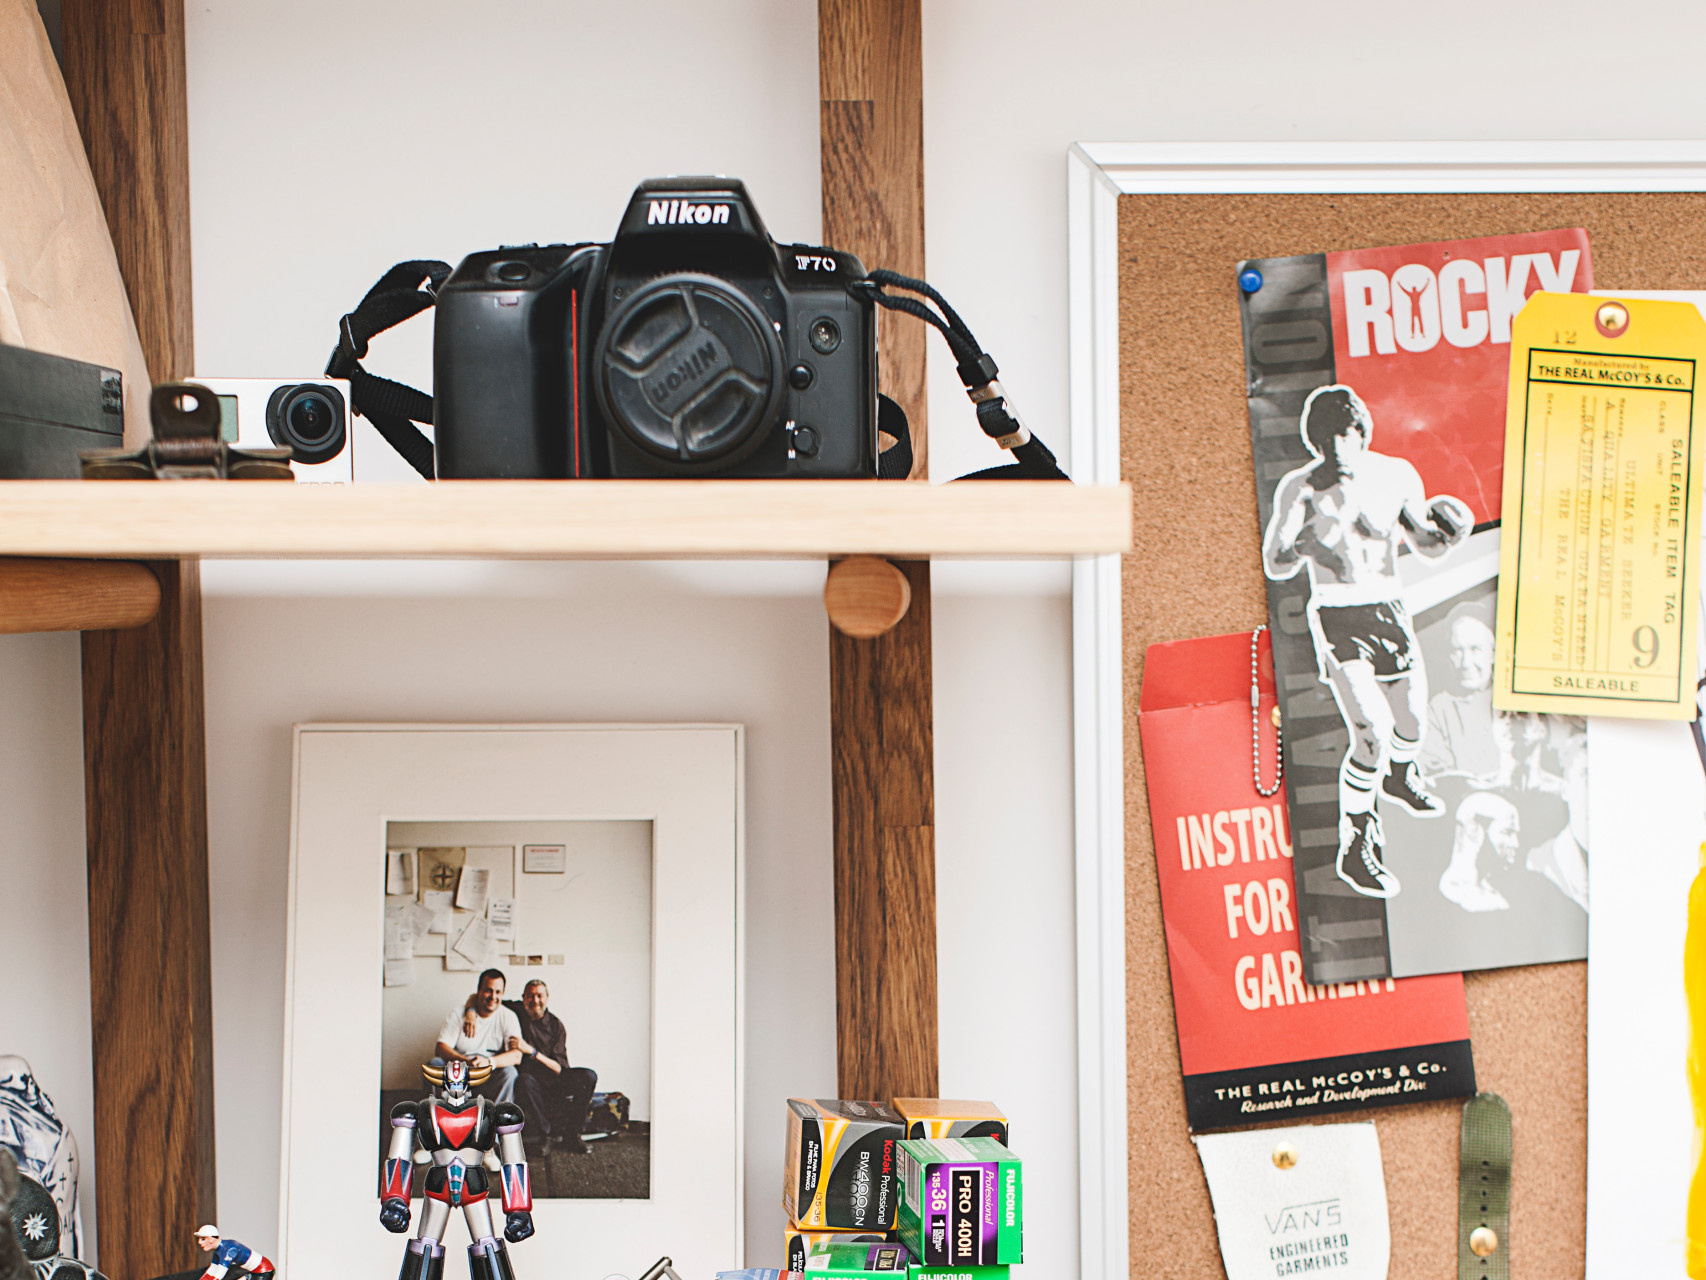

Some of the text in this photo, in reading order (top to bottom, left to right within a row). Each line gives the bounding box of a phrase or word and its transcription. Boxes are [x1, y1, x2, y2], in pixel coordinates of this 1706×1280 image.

[648, 200, 730, 224] Nikon
[795, 255, 836, 272] F70
[1342, 249, 1581, 358] ROCKY
[652, 340, 720, 400] Nikon
[1538, 365, 1686, 386] THE REAL McCOY'S & Co.
[785, 420, 796, 431] AF
[788, 450, 796, 460] M
[1664, 438, 1683, 624] SALEABLE ITEM TAG
[1632, 625, 1659, 668] 9
[1553, 675, 1640, 692] SALEABLE
[1176, 804, 1294, 871] INSTRU
[1223, 877, 1295, 939] FOR
[1214, 1061, 1447, 1101] THE REAL McCOY'S & Co.
[1240, 1094, 1293, 1114] Research
[1296, 1090, 1319, 1106] and
[1322, 1079, 1401, 1103] Development
[854, 1151, 870, 1226] BW400CN
[877, 1139, 893, 1225] Kodak Professional
[931, 1171, 947, 1211] 135 36
[984, 1170, 995, 1225] Professional
[1005, 1168, 1016, 1227] FUJICOLOR
[813, 1192, 823, 1222] 135-36
[932, 1219, 946, 1227] 1
[957, 1175, 973, 1257] PRO 400H
[1264, 1198, 1342, 1235] VANS
[1270, 1233, 1349, 1260] ENGINEERED
[1276, 1251, 1349, 1277] GARMENTS
